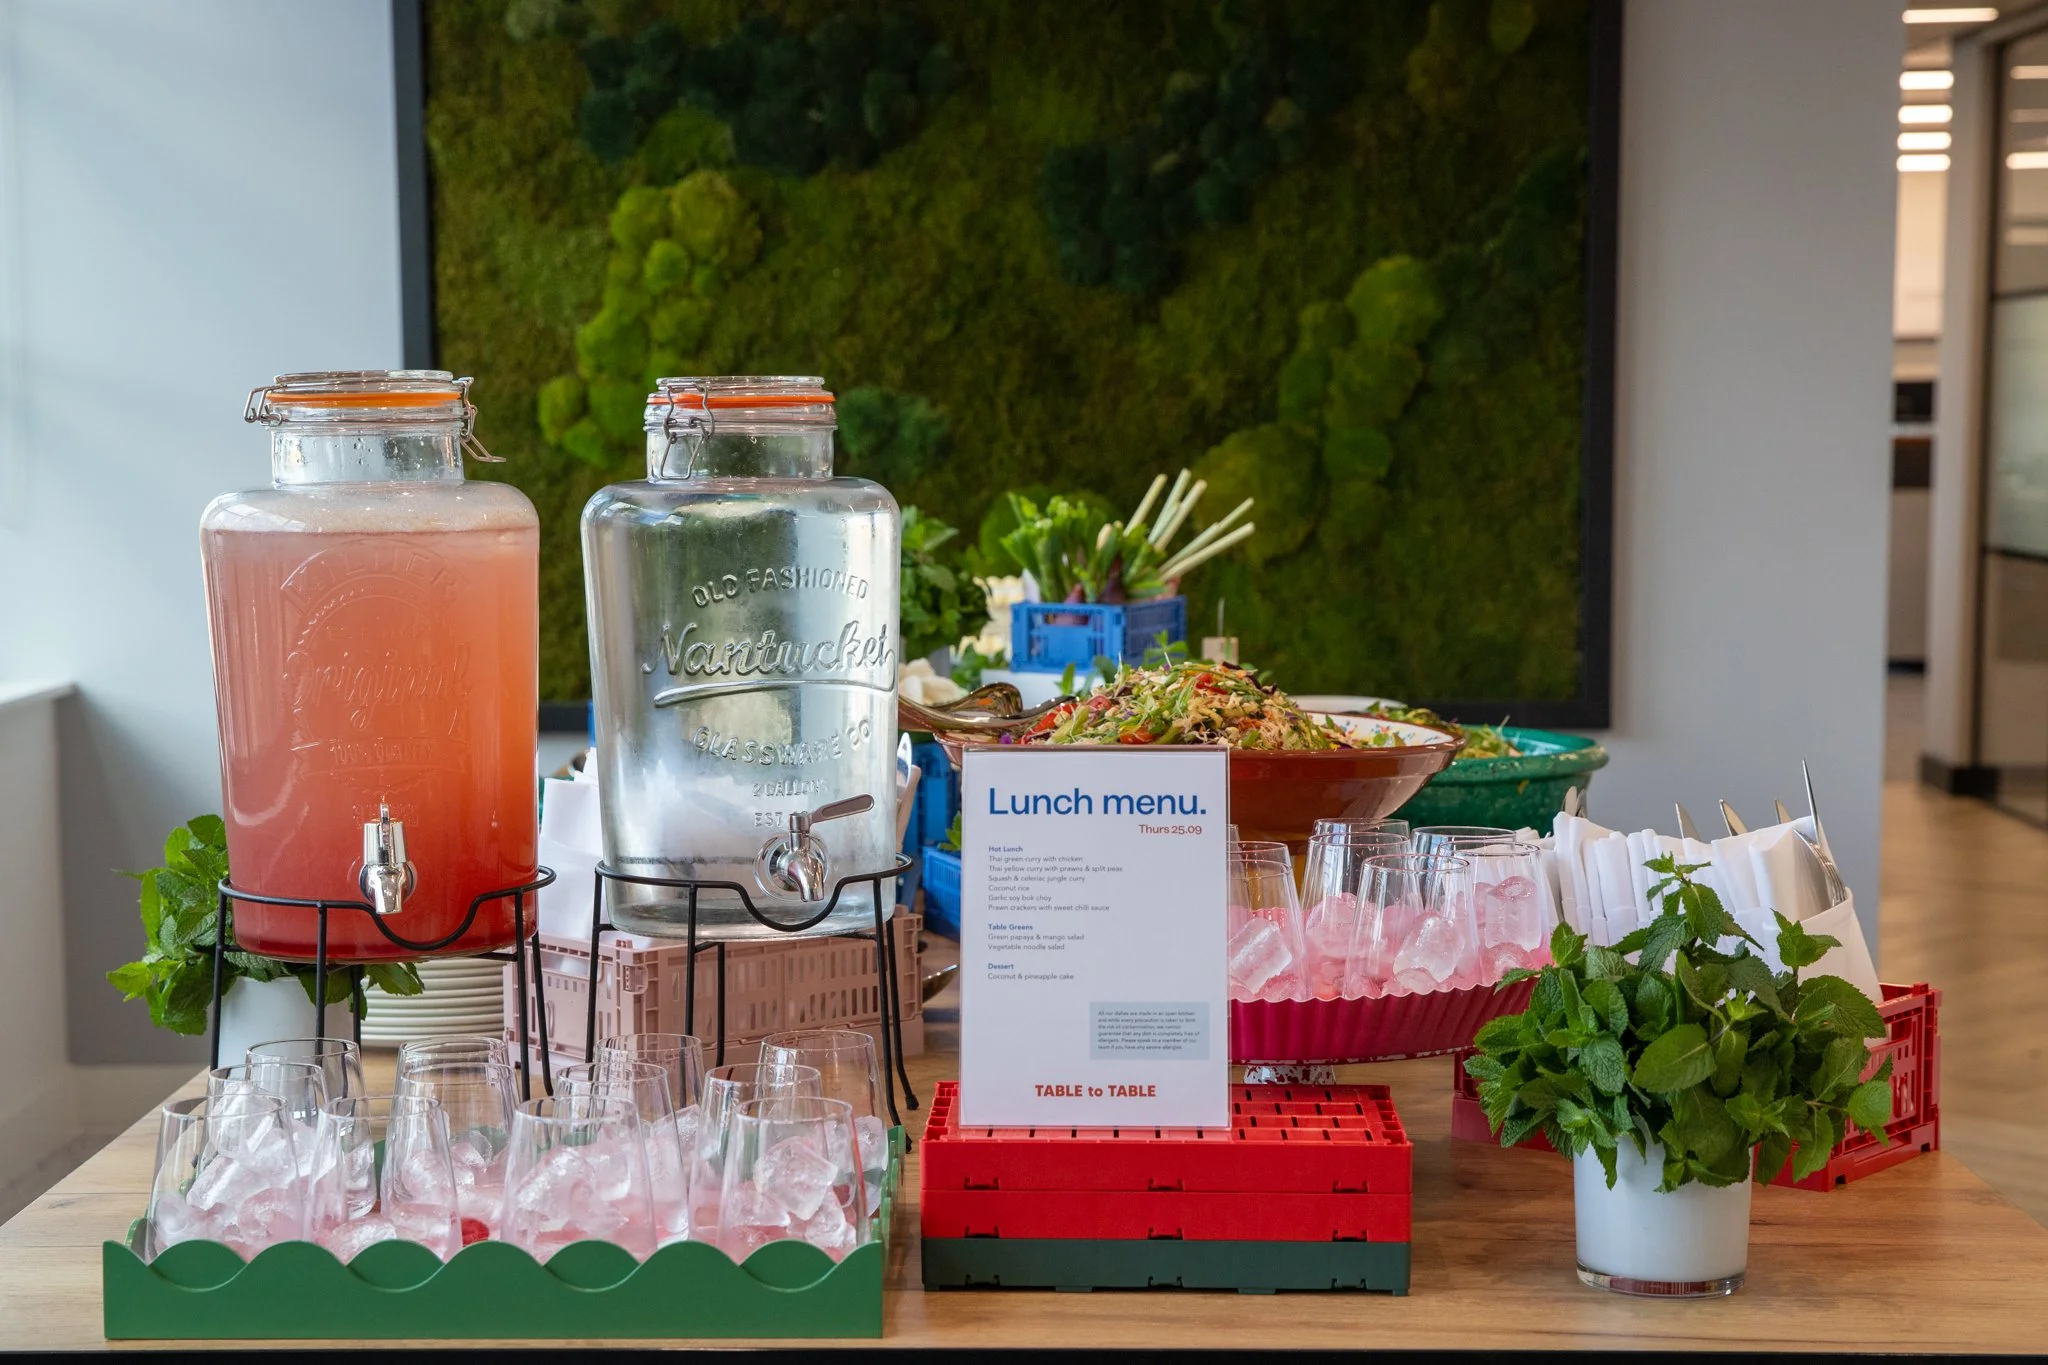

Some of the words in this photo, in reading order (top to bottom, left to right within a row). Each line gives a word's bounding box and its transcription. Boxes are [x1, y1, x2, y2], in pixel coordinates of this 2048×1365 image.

[691, 573, 739, 607] OLD
[747, 566, 869, 600] FASHIONED
[641, 620, 893, 676] Nantucket
[693, 726, 842, 767] GLASSWARE
[752, 783, 762, 797] 2
[989, 787, 1093, 815] Lunch
[1103, 794, 1206, 816] menu.
[754, 811, 784, 828] EST
[1138, 824, 1170, 834] Thurs
[1171, 825, 1202, 835] 25.09
[1004, 865, 1025, 873] yellow
[1046, 875, 1068, 883] jungle
[1035, 894, 1052, 903] choy
[987, 943, 1022, 952] Vegetable
[987, 972, 1016, 980] Coconut
[1024, 972, 1058, 981] pineapple
[1034, 1084, 1083, 1097] TABLE
[1087, 1086, 1104, 1098] to
[1107, 1084, 1156, 1097] TABLE
